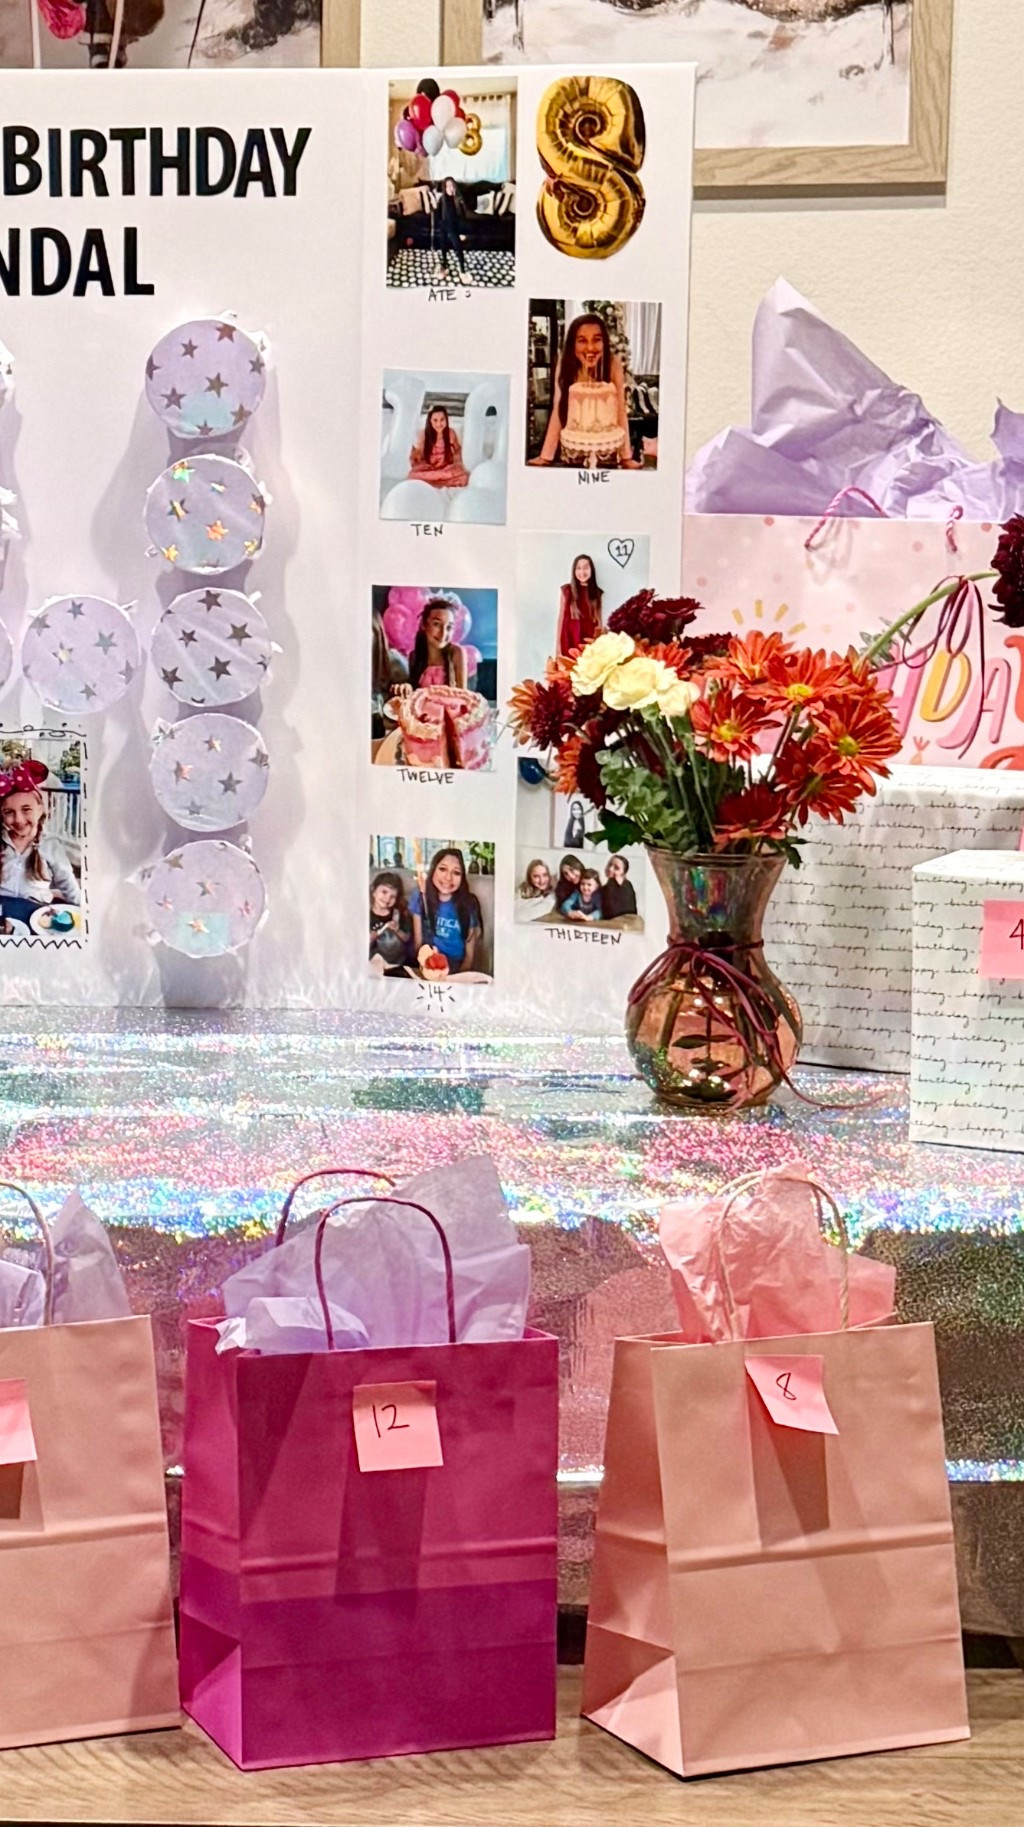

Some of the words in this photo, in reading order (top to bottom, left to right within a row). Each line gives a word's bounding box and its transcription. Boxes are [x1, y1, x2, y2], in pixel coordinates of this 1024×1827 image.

[1, 125, 313, 198] BIRTHDAY
[428, 288, 457, 301] ATE
[578, 471, 611, 485] NINE
[410, 523, 444, 537] TEN
[615, 545, 629, 557] 11
[397, 768, 455, 785] TWELVE
[545, 927, 622, 946] THIRTEEN
[427, 983, 444, 1002] 14
[775, 1371, 797, 1403] 8
[373, 1403, 410, 1439] 12
